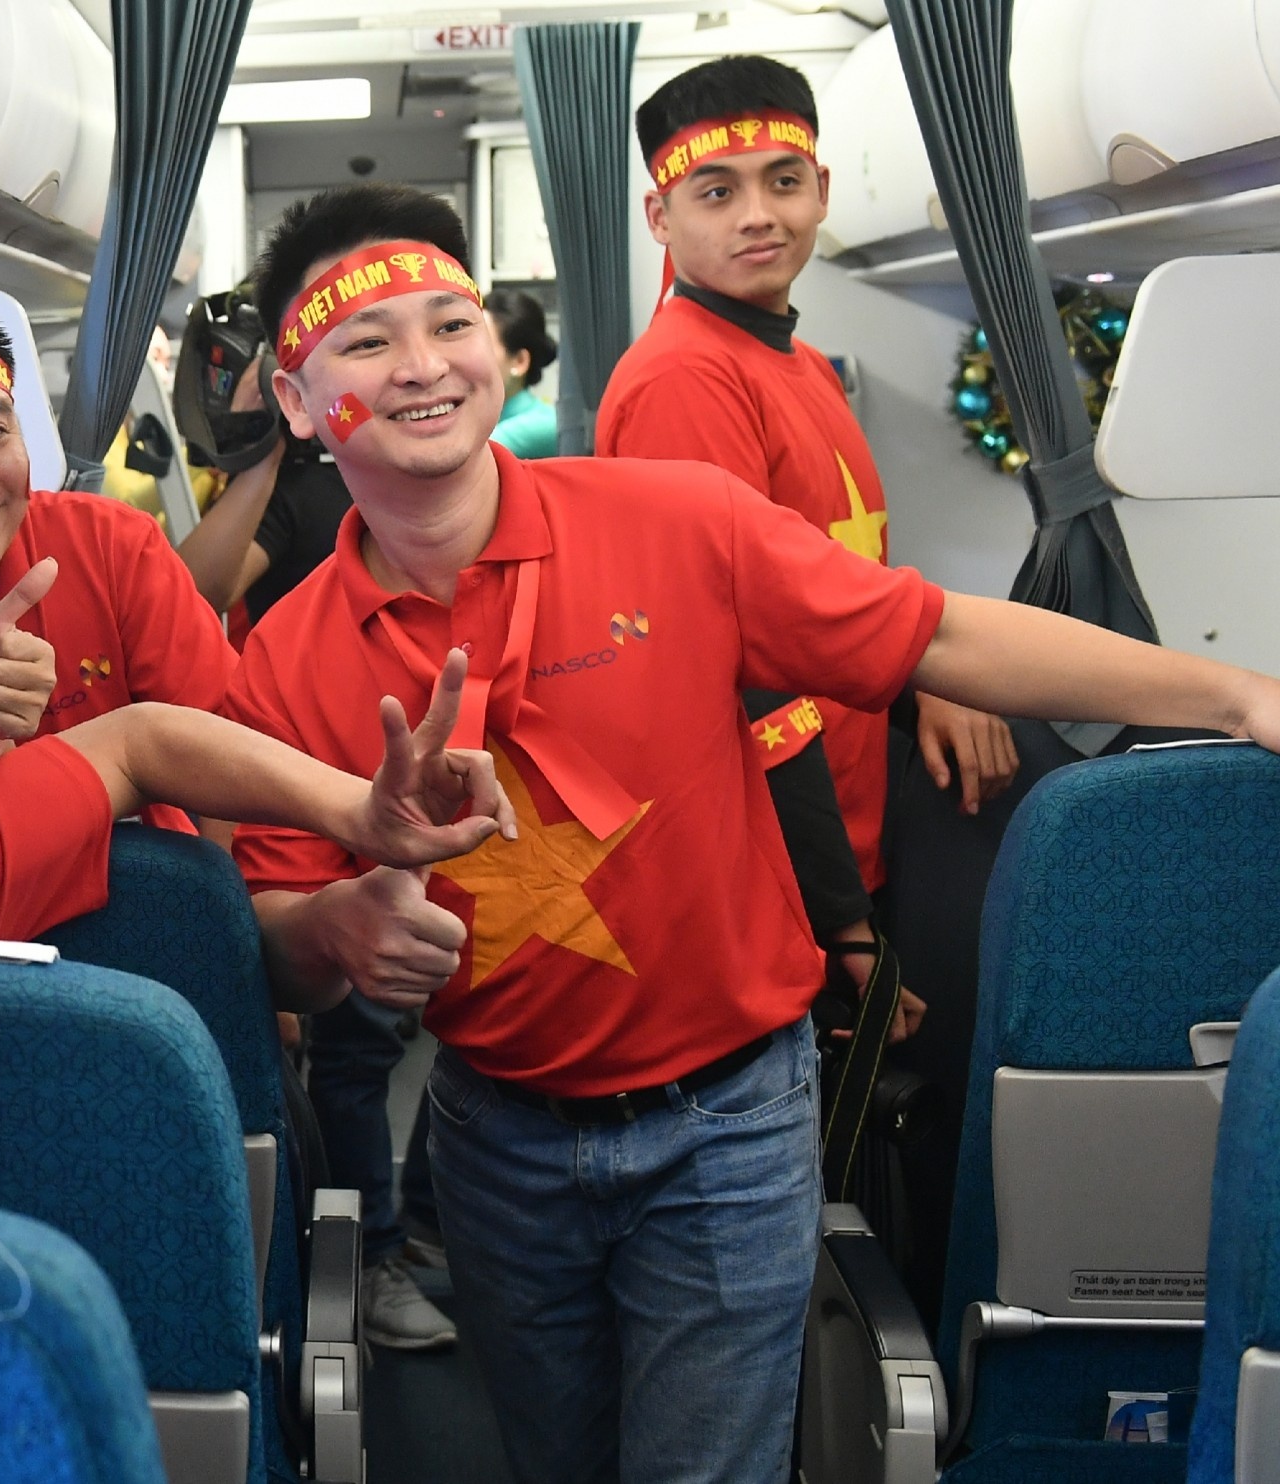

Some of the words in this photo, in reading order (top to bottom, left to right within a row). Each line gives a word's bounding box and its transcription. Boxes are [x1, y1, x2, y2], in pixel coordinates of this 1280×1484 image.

[448, 24, 509, 49] EXIT
[665, 143, 690, 178] VIỆT
[689, 126, 730, 161] NAM
[768, 120, 809, 152] NASCO
[298, 286, 336, 333] VIỆT
[335, 260, 391, 303] NAM
[530, 647, 618, 681] NASCO
[1074, 1287, 1109, 1296] Fasten
[1111, 1288, 1133, 1296] seat
[1135, 1287, 1155, 1297] belt
[1157, 1288, 1184, 1298] while
[1122, 1277, 1136, 1285] an
[1164, 1277, 1191, 1288] trong
